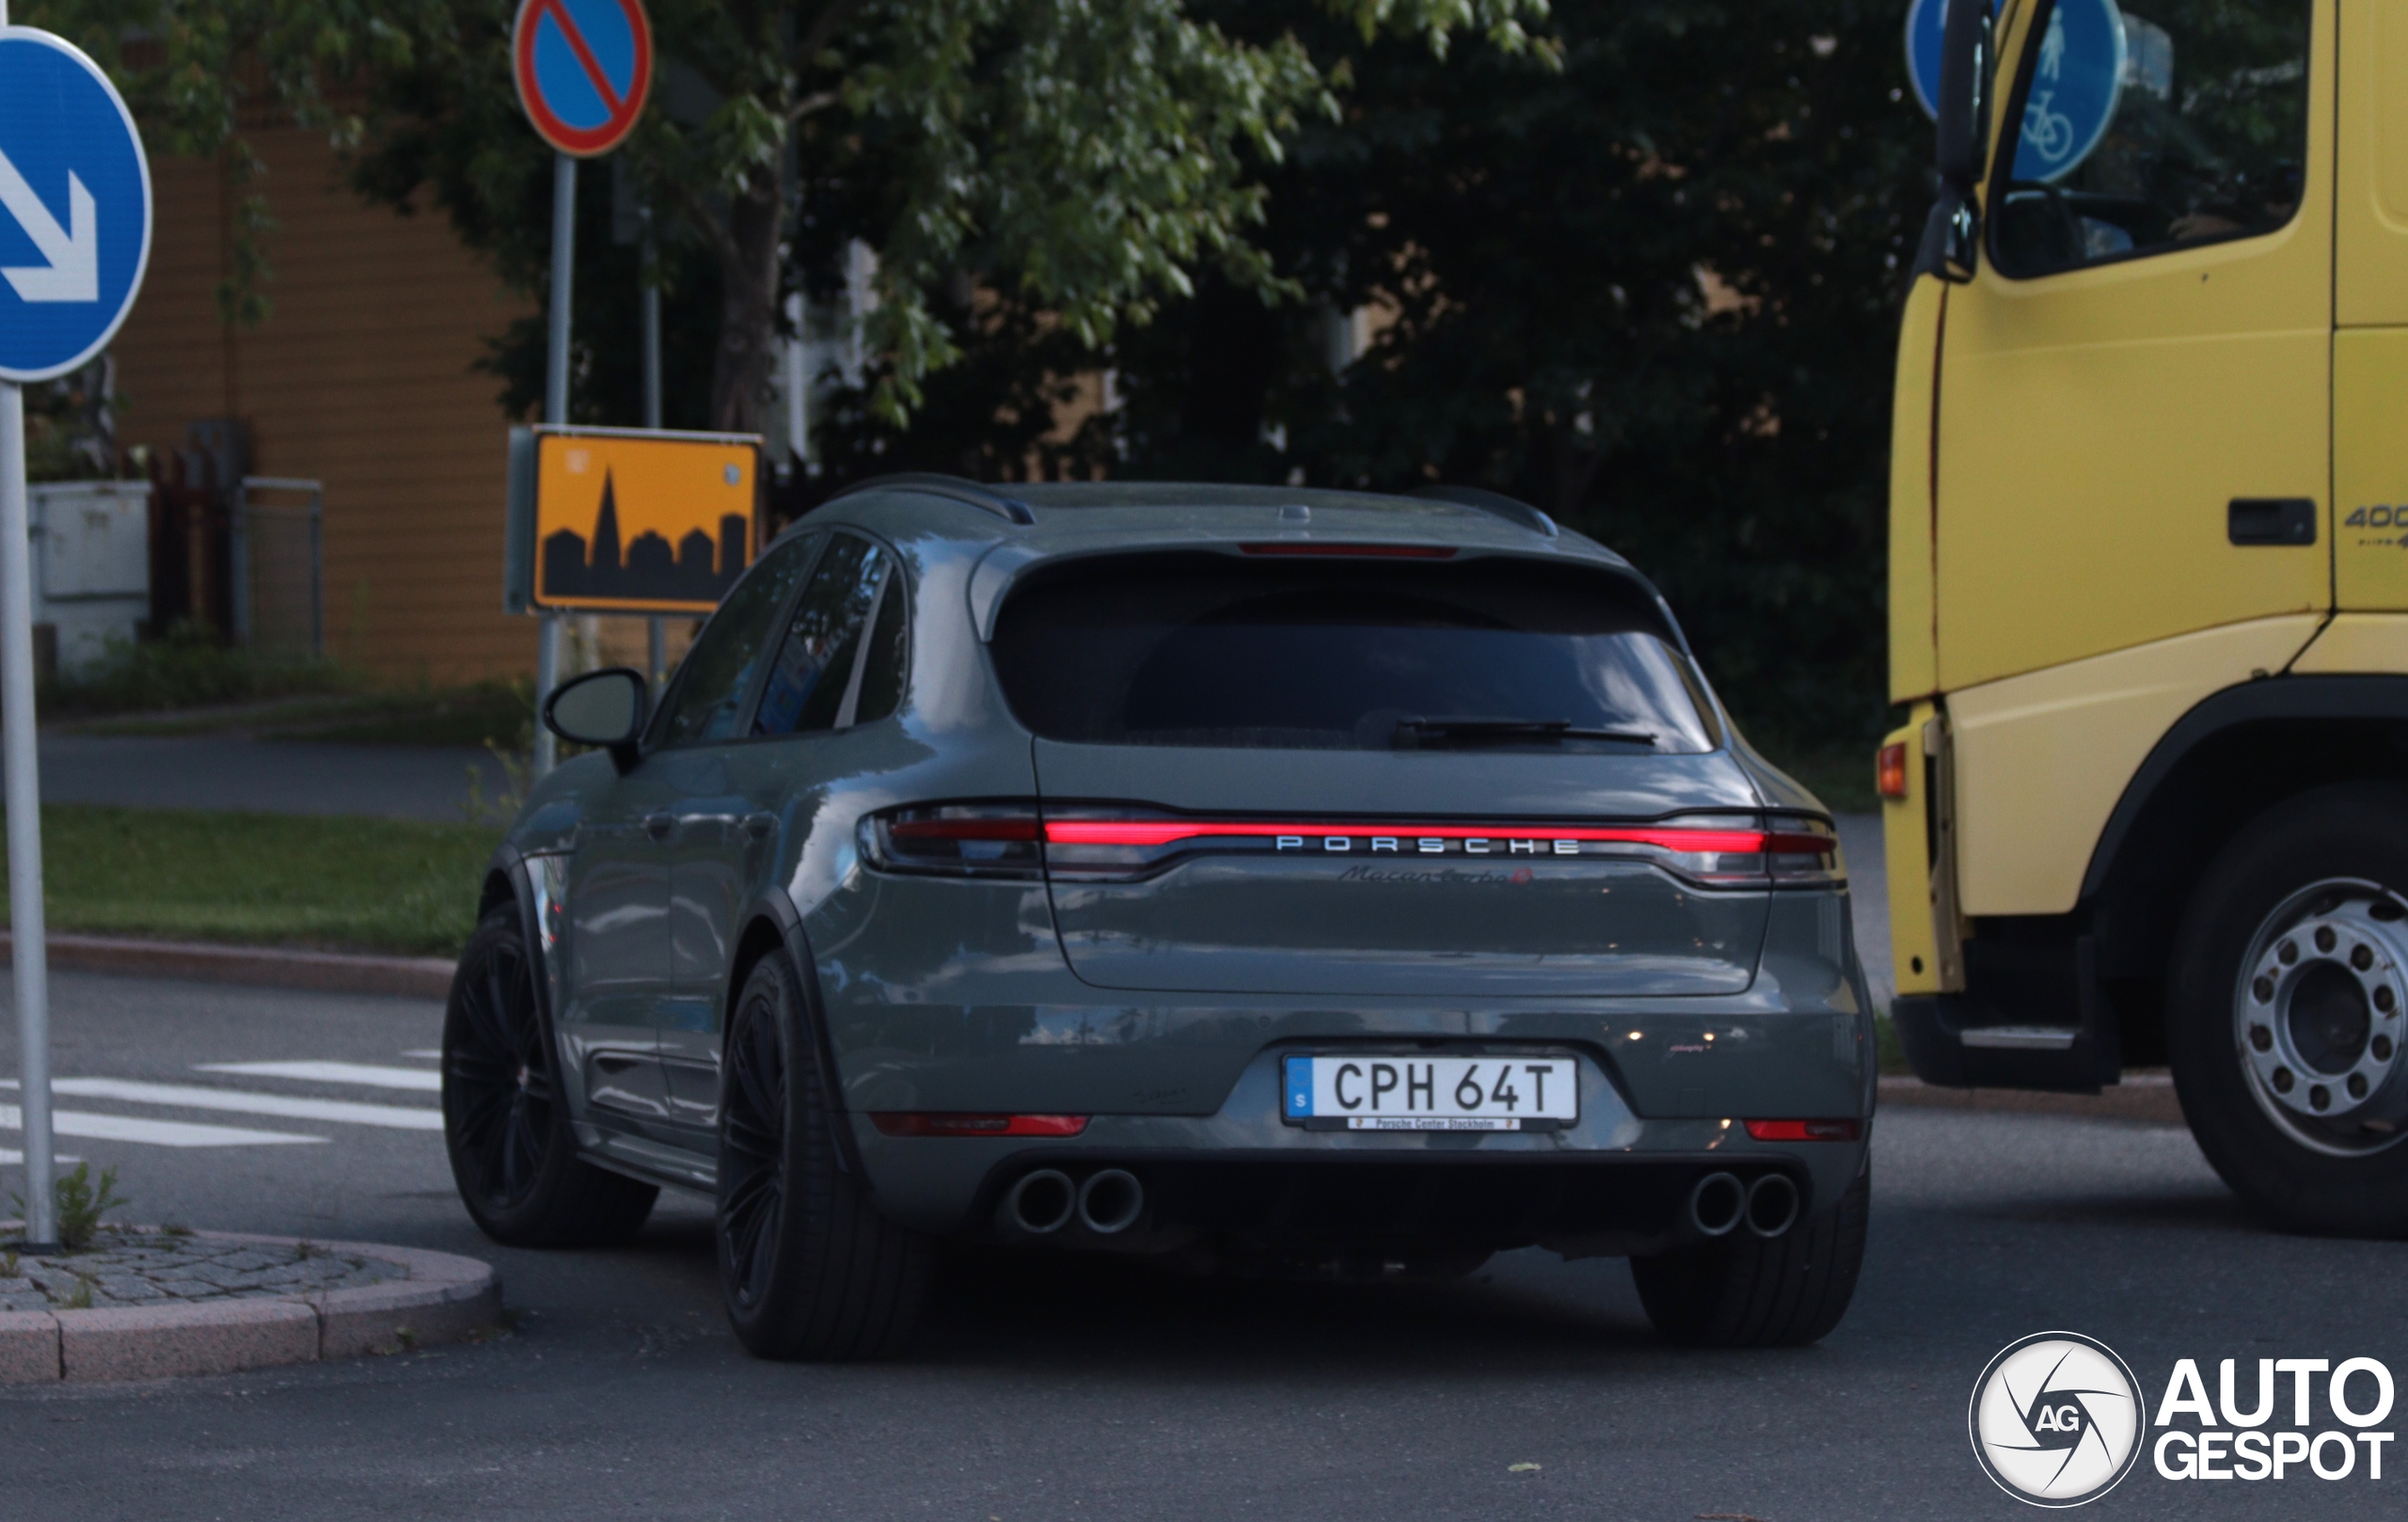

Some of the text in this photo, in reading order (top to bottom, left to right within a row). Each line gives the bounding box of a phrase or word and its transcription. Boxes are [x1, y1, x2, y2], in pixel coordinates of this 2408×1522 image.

[1275, 835, 1579, 854] PORSCHE
[1334, 1063, 1553, 1112] CPH 64T
[1295, 1094, 1307, 1107] S
[1376, 1118, 1495, 1129] Porsche Center Stockholm
